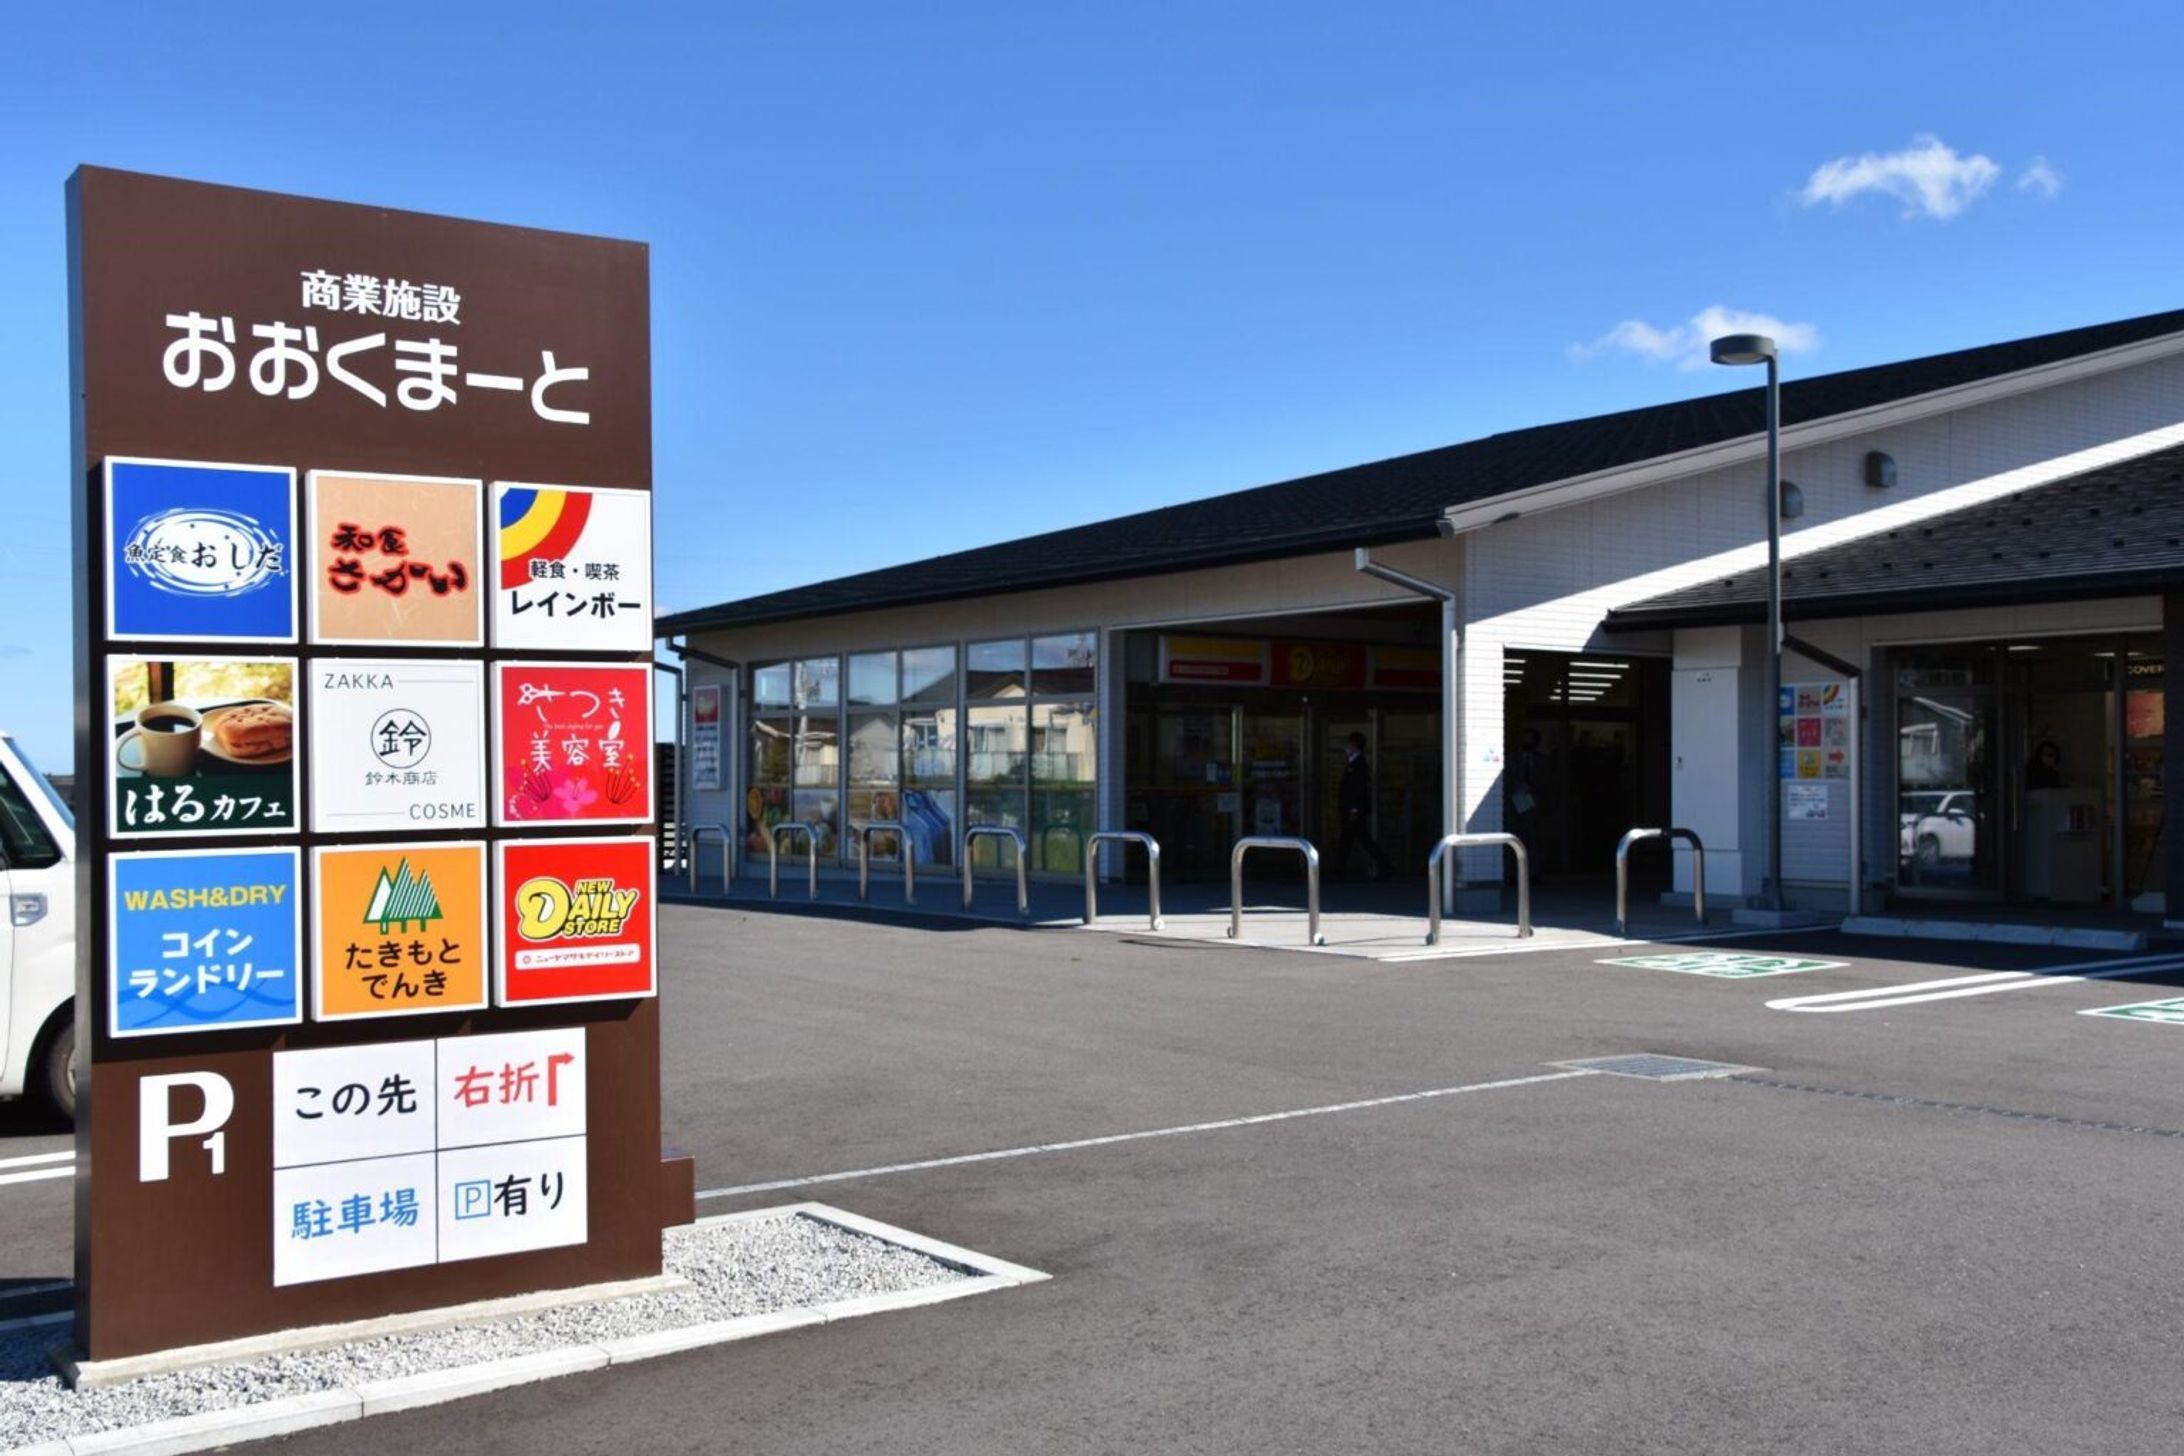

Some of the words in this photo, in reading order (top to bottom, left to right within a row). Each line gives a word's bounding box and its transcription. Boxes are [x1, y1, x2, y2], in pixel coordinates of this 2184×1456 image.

[300, 269, 461, 325] 商業施設
[162, 311, 590, 425] おおくまーと
[331, 522, 410, 556] 和食
[530, 560, 620, 581] 軽食・喫茶
[511, 590, 641, 619] レインボー
[323, 673, 395, 690] ZAKKA
[378, 719, 428, 757] 鈴
[530, 729, 625, 773] 美容室
[365, 771, 438, 786] 鈴木商店
[409, 803, 477, 820] COSME
[124, 884, 287, 911] WASH&DRY
[577, 880, 612, 893] NEW
[563, 919, 621, 936] STORE
[162, 928, 254, 959] コイン
[345, 938, 462, 970] たきもと
[129, 962, 284, 999] ランドリー
[362, 969, 448, 999] でんき
[296, 1074, 417, 1120] この先
[454, 1061, 539, 1108] 右折
[291, 1188, 419, 1239] 駐車場
